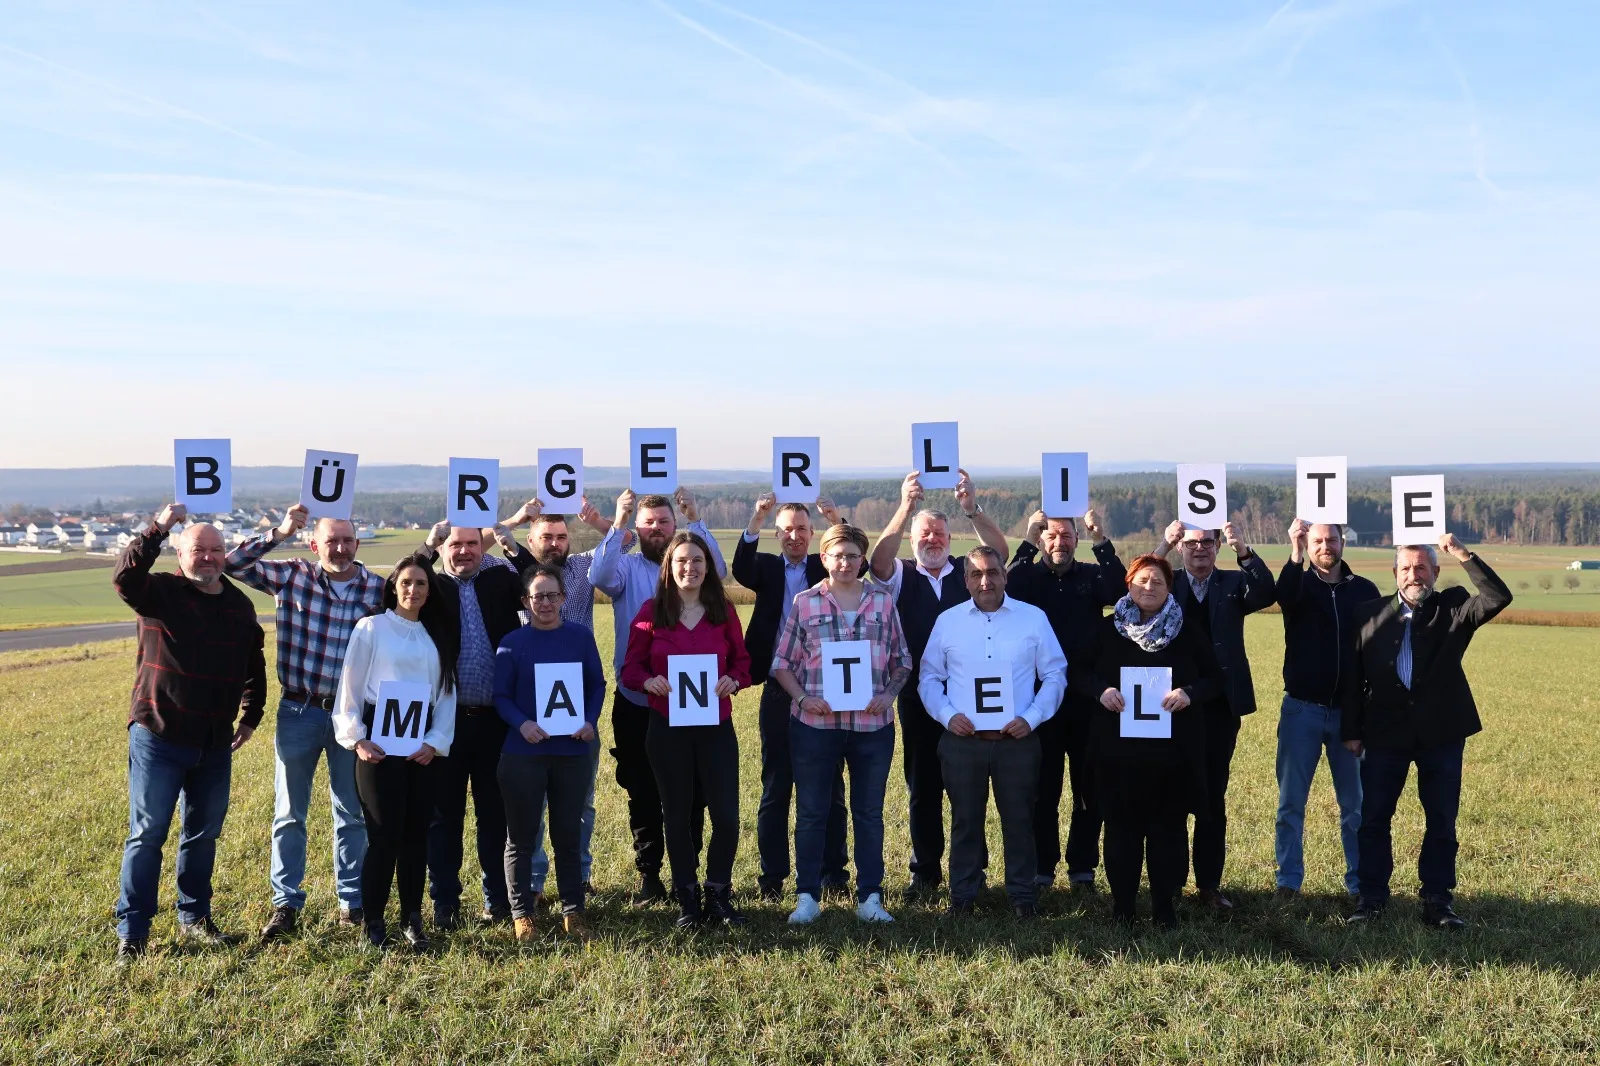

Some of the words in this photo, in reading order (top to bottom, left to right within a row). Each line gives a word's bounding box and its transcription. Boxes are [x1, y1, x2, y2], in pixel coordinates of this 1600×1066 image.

[641, 444, 667, 478] E
[782, 453, 812, 487] R
[924, 439, 949, 473] L
[186, 457, 221, 495] B
[312, 459, 346, 502] Ü
[458, 474, 490, 511] R
[545, 464, 576, 498] G
[1061, 468, 1068, 501] I
[1307, 473, 1335, 507] T
[1188, 480, 1216, 514] S
[1404, 492, 1433, 527] E
[679, 671, 708, 708] N
[832, 657, 860, 693] T
[544, 680, 577, 718] A
[974, 677, 1003, 713] E
[1134, 685, 1160, 720] L
[381, 699, 423, 739] M
